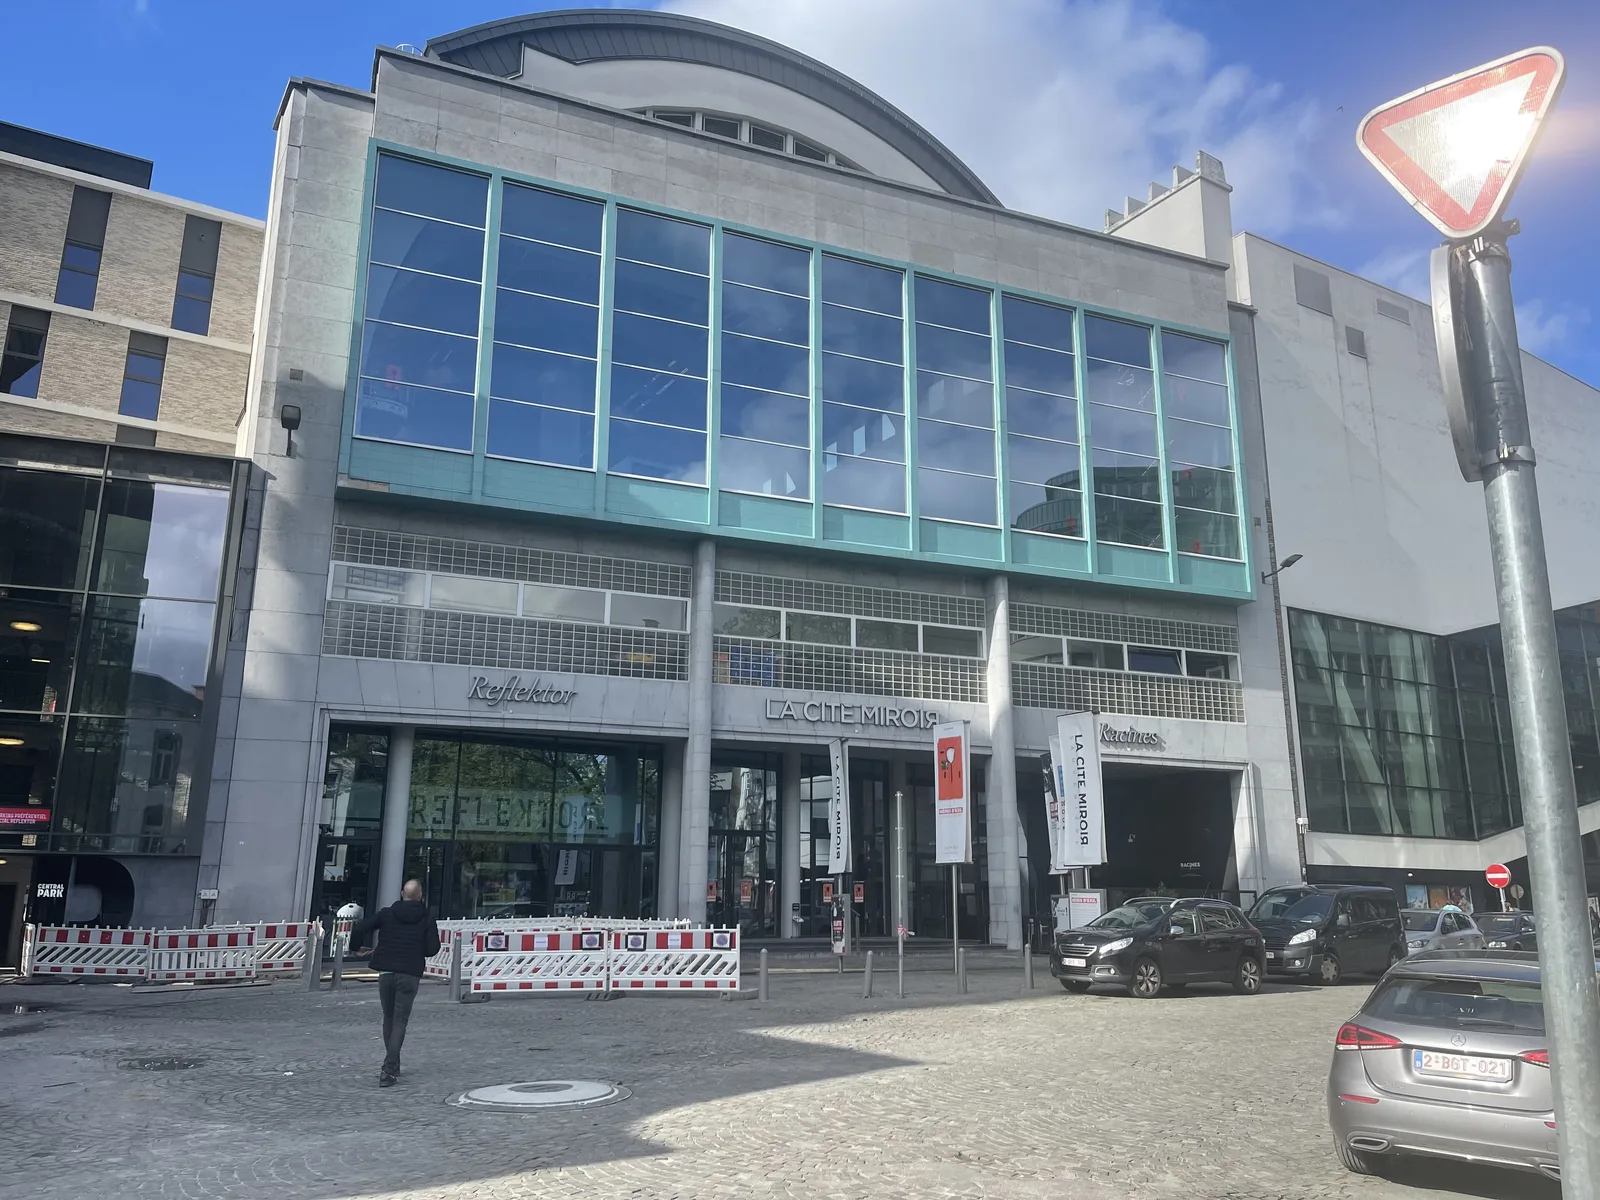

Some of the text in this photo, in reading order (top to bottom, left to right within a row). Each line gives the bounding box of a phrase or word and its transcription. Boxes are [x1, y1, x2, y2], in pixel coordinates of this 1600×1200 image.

[468, 676, 578, 706] Reflektor
[766, 698, 798, 720] LA
[1074, 734, 1084, 752] LA
[1099, 722, 1158, 745] Racines
[1075, 756, 1087, 788] CITE
[37, 889, 63, 897] PARK
